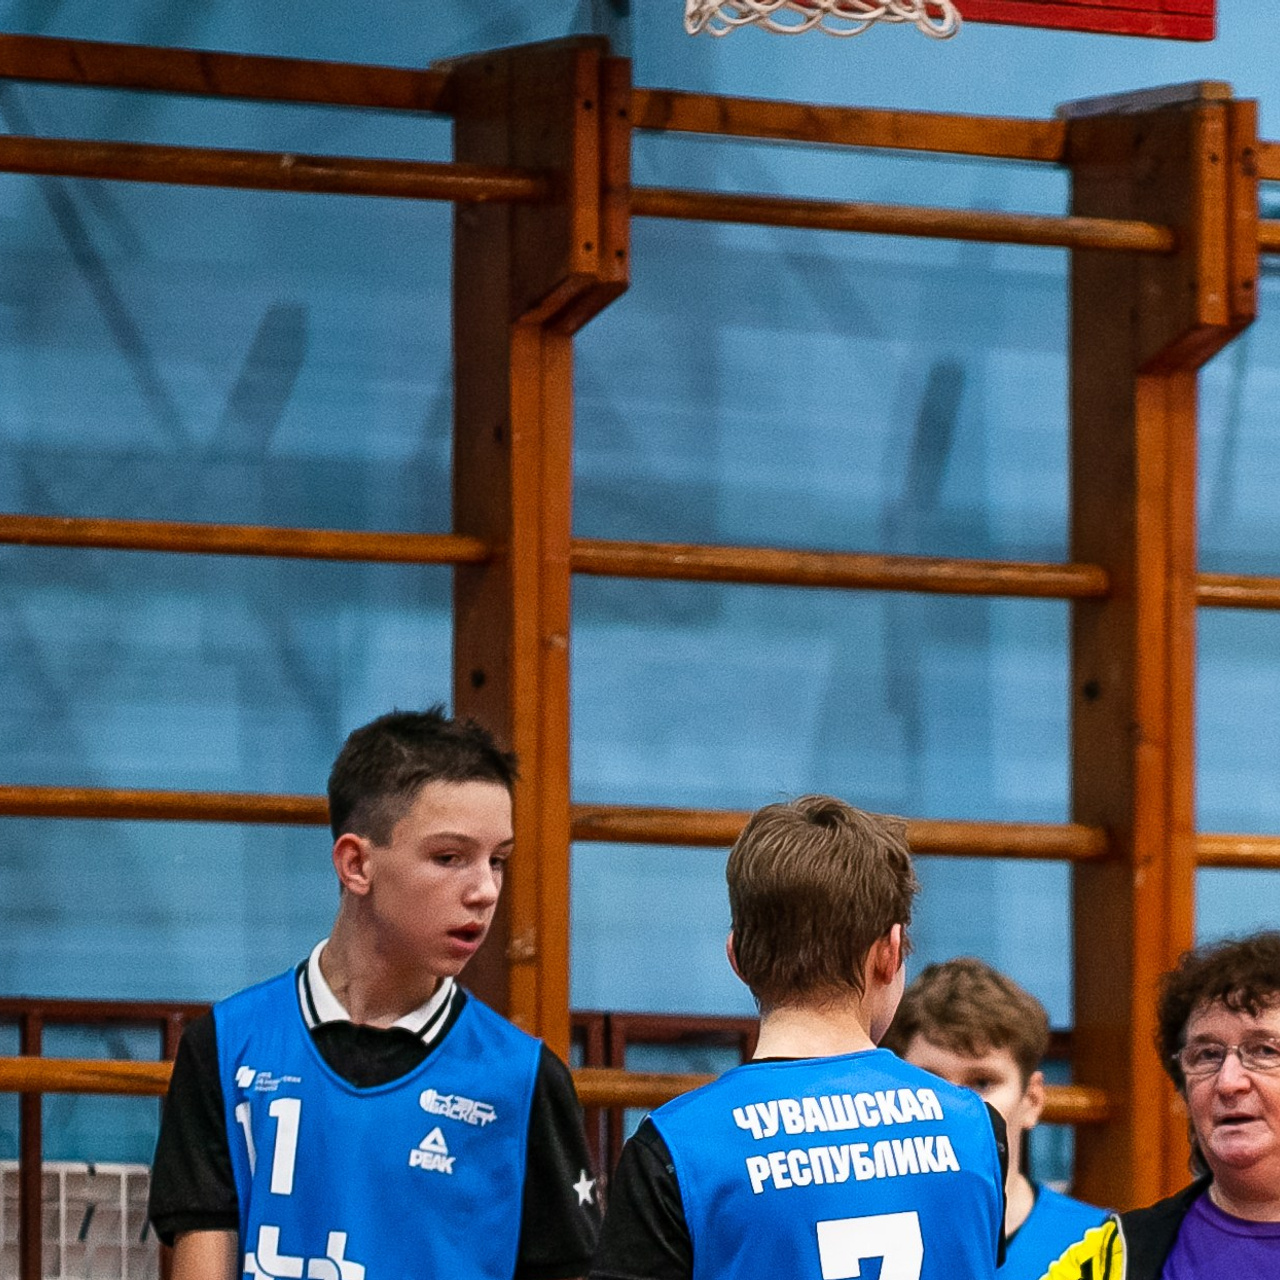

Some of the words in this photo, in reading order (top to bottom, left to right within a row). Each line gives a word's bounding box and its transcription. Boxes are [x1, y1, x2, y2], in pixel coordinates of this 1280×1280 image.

[733, 1088, 944, 1140] ЧУВАШСКАЯ
[409, 1149, 456, 1175] PEAK
[746, 1136, 960, 1194] РЕСПУБЛИКА
